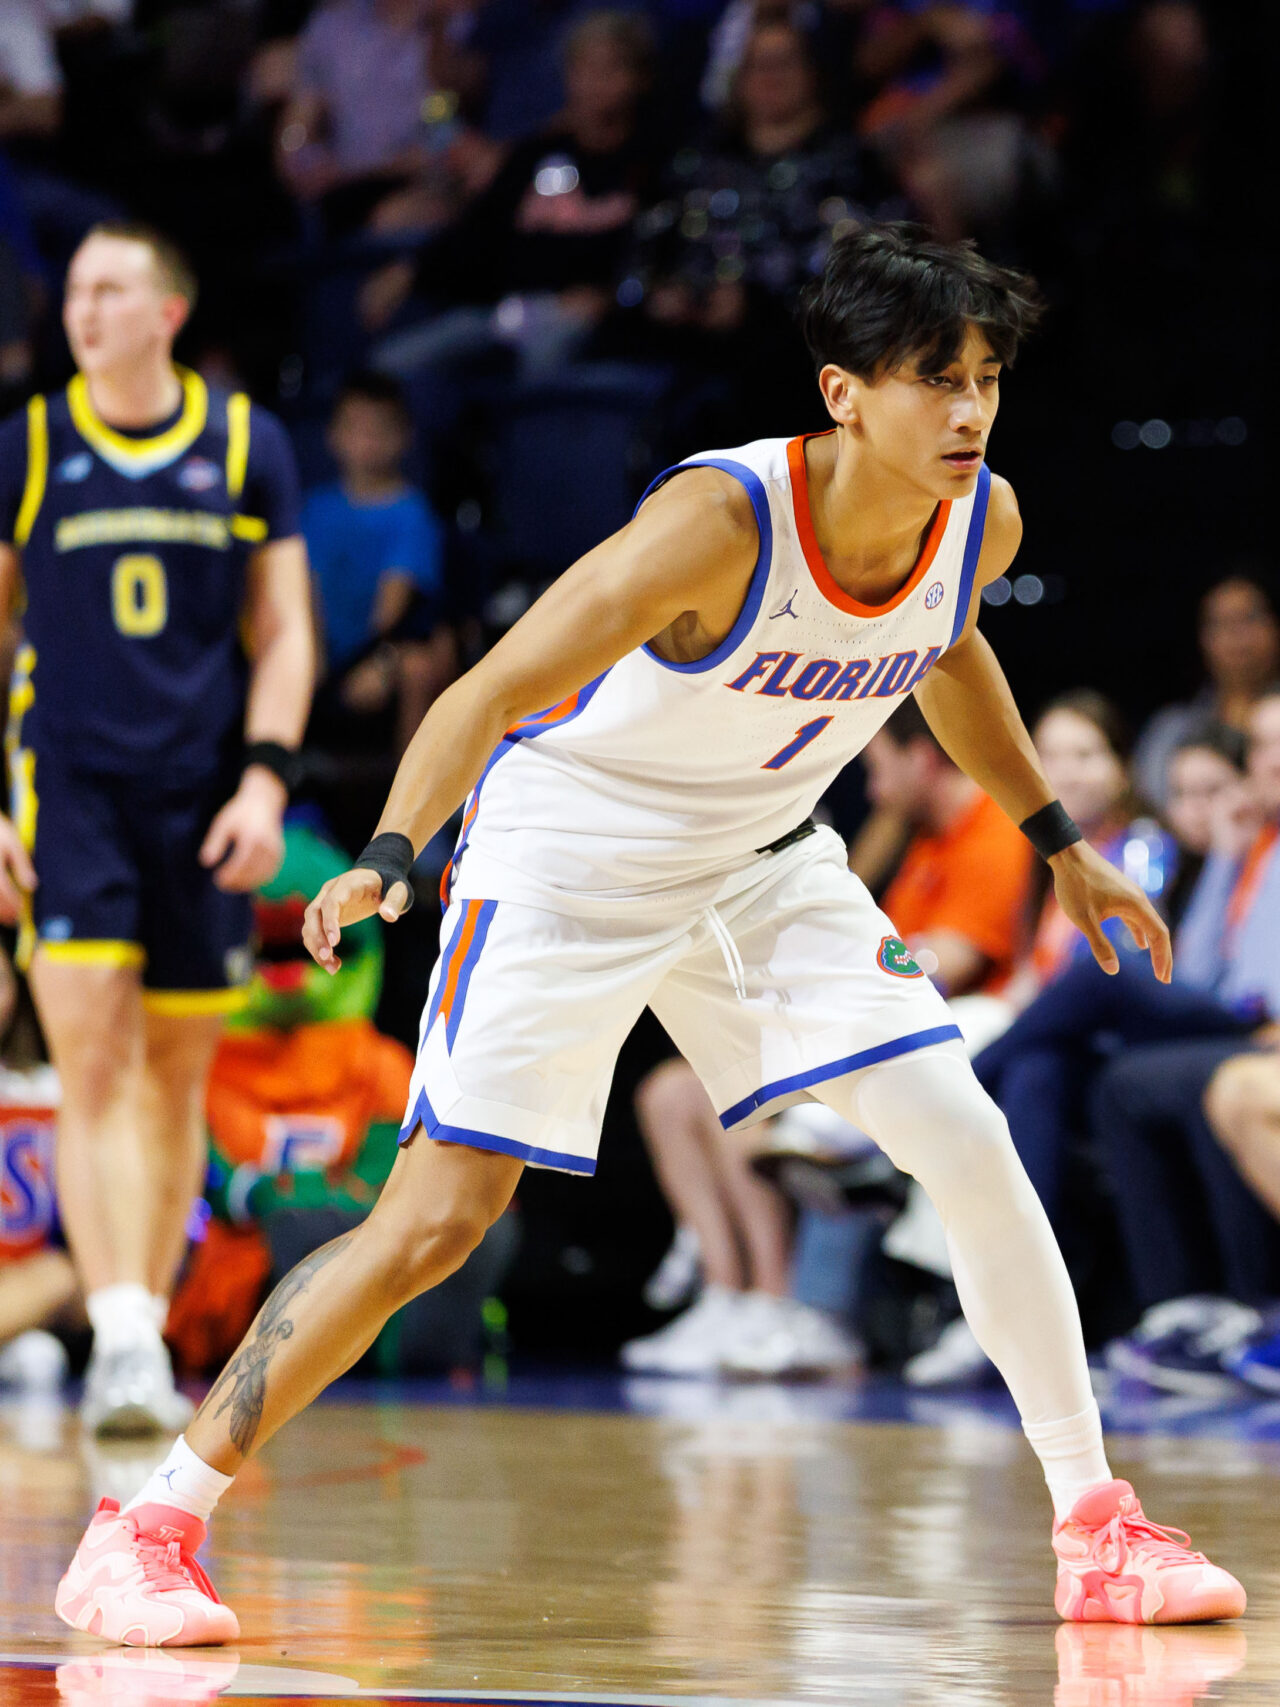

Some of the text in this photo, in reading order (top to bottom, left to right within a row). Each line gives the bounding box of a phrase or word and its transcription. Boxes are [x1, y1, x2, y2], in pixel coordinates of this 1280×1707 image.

[111, 553, 168, 638] 0
[723, 645, 943, 701] FLORIDA
[760, 715, 835, 770] 1
